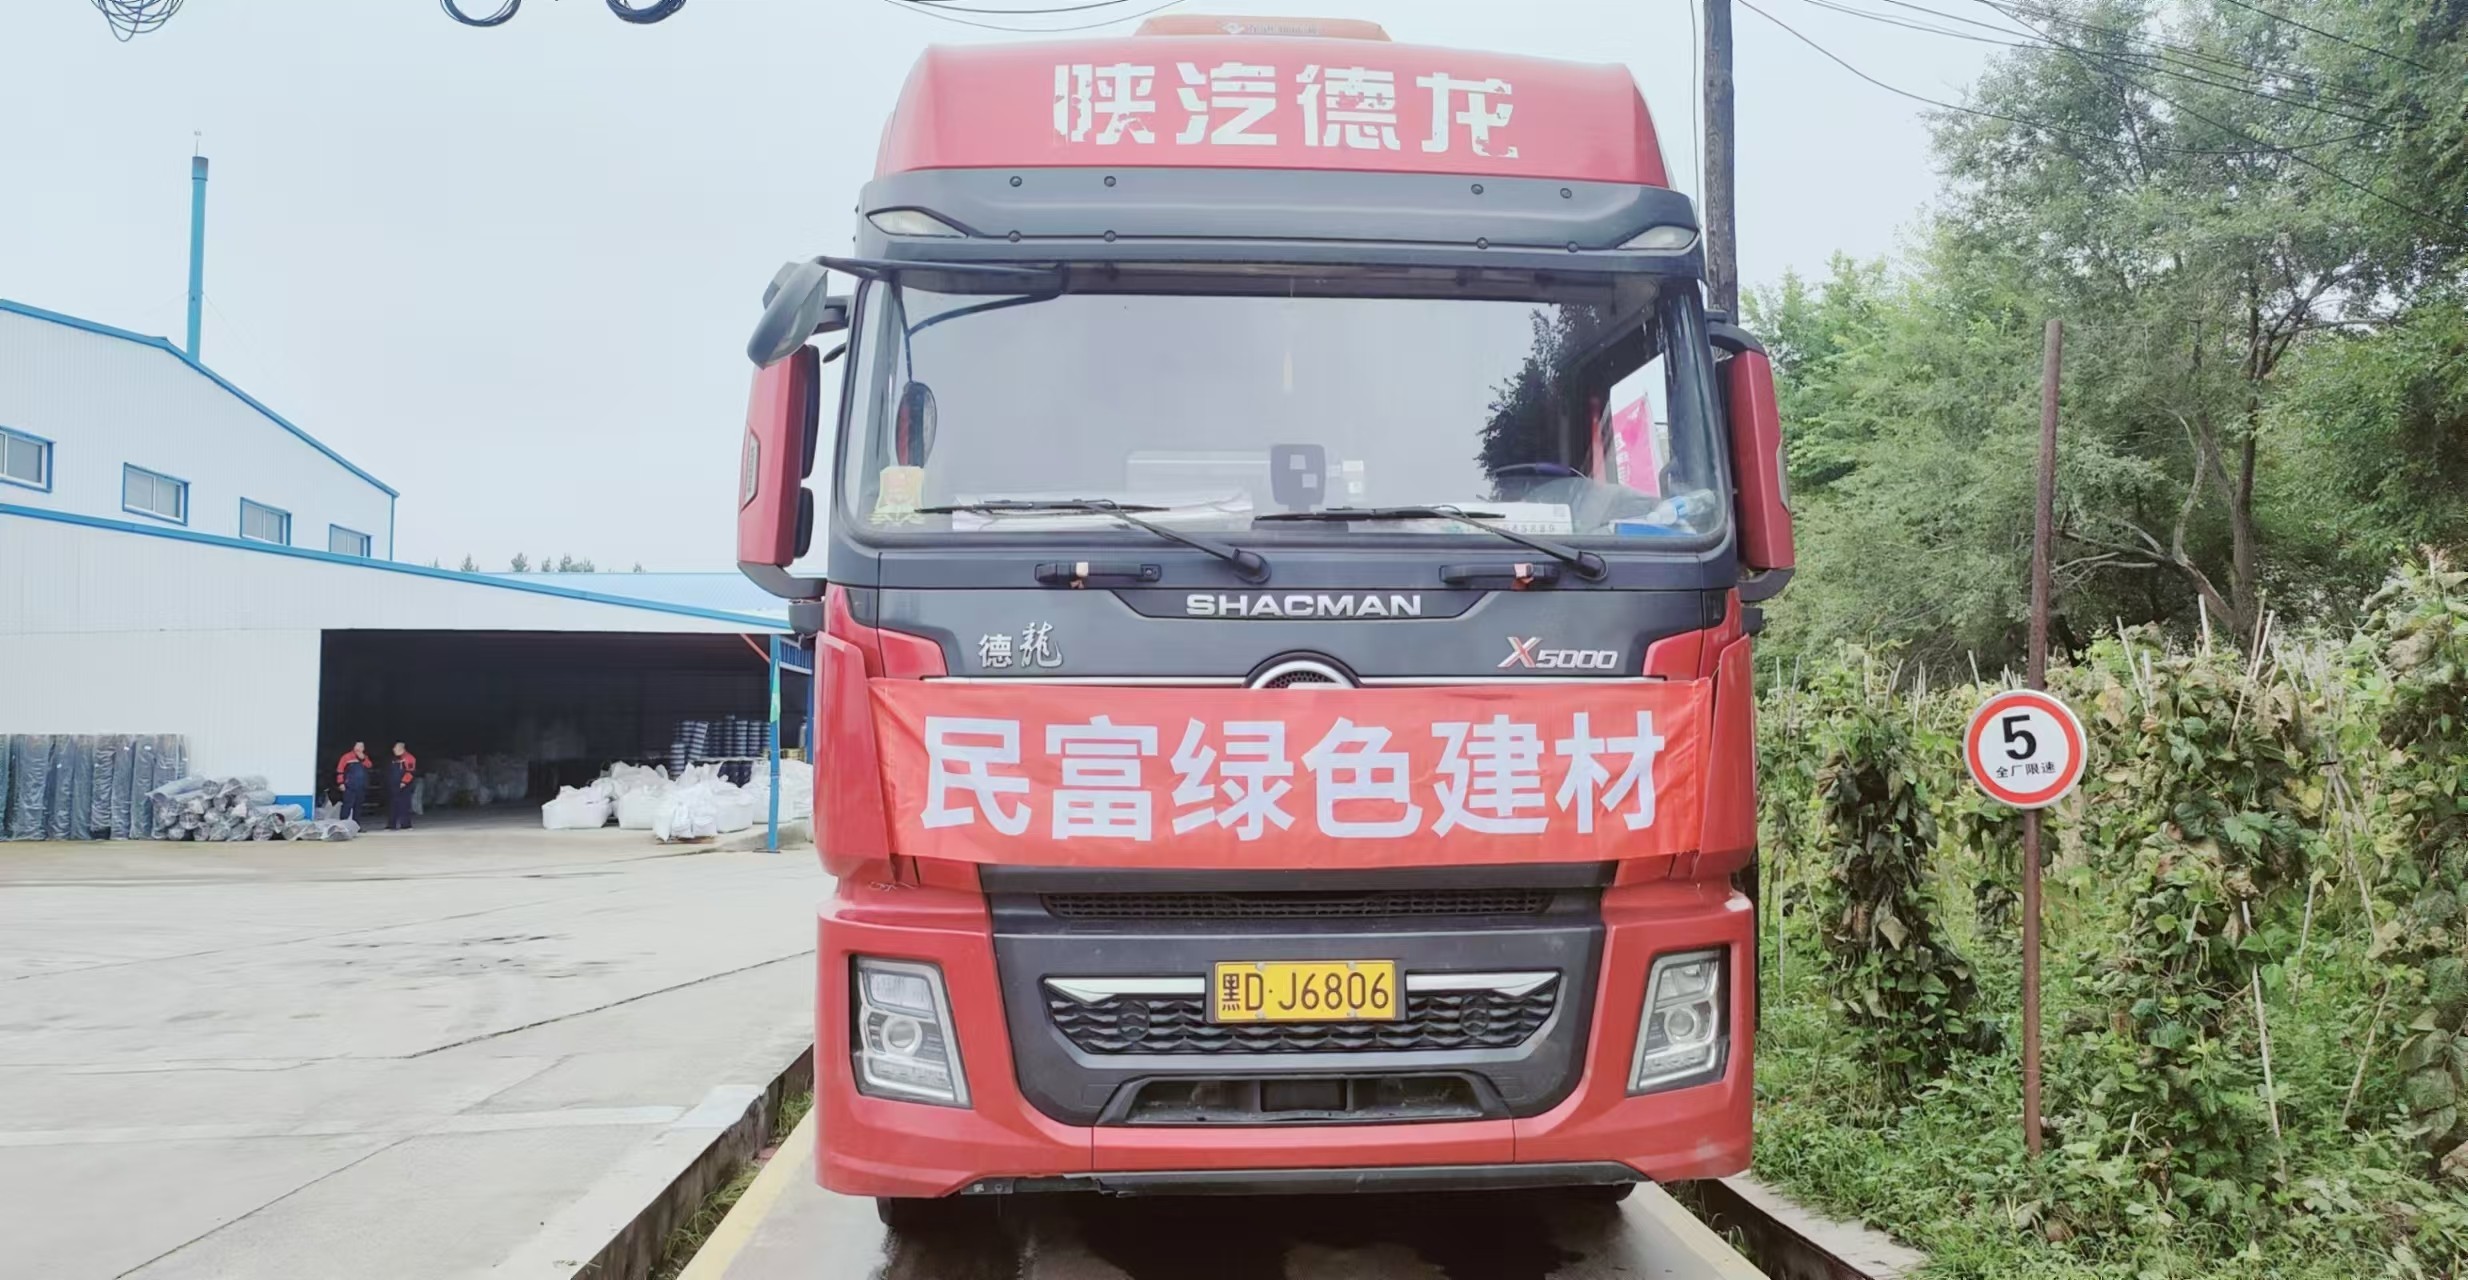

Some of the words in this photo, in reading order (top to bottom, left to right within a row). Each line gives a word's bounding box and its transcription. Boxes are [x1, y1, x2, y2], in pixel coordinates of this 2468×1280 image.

[1053, 62, 1519, 158] 陕汽德龙
[1186, 594, 1421, 616] SHACMAN
[1497, 636, 1618, 669] X5000
[2002, 714, 2037, 760] 5
[919, 710, 1665, 841] 民富绿色建材
[1996, 761, 2056, 779] 全厂限速
